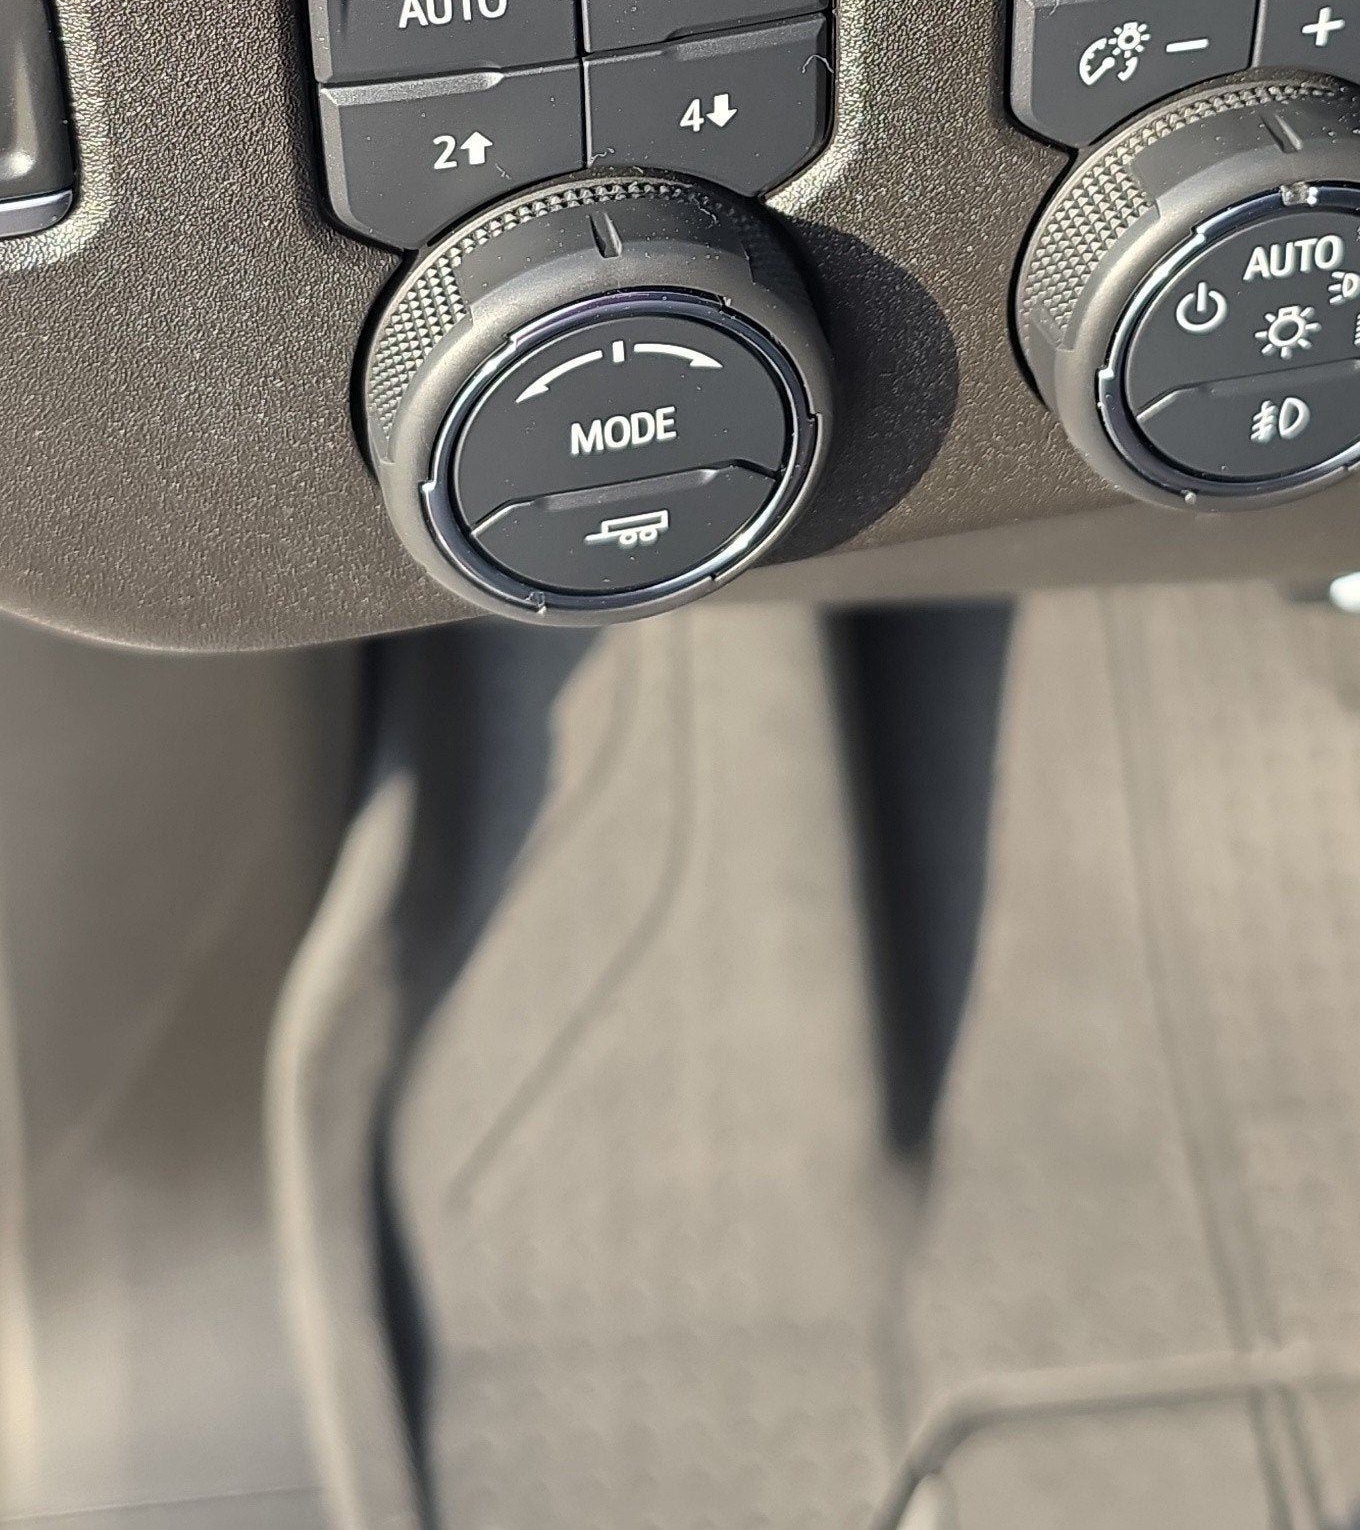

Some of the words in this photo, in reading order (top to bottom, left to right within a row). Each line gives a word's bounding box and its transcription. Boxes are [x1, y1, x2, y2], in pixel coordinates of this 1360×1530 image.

[678, 98, 705, 133] 4
[432, 134, 459, 171] 2
[1242, 234, 1344, 282] AUTO
[570, 405, 677, 456] MODE
